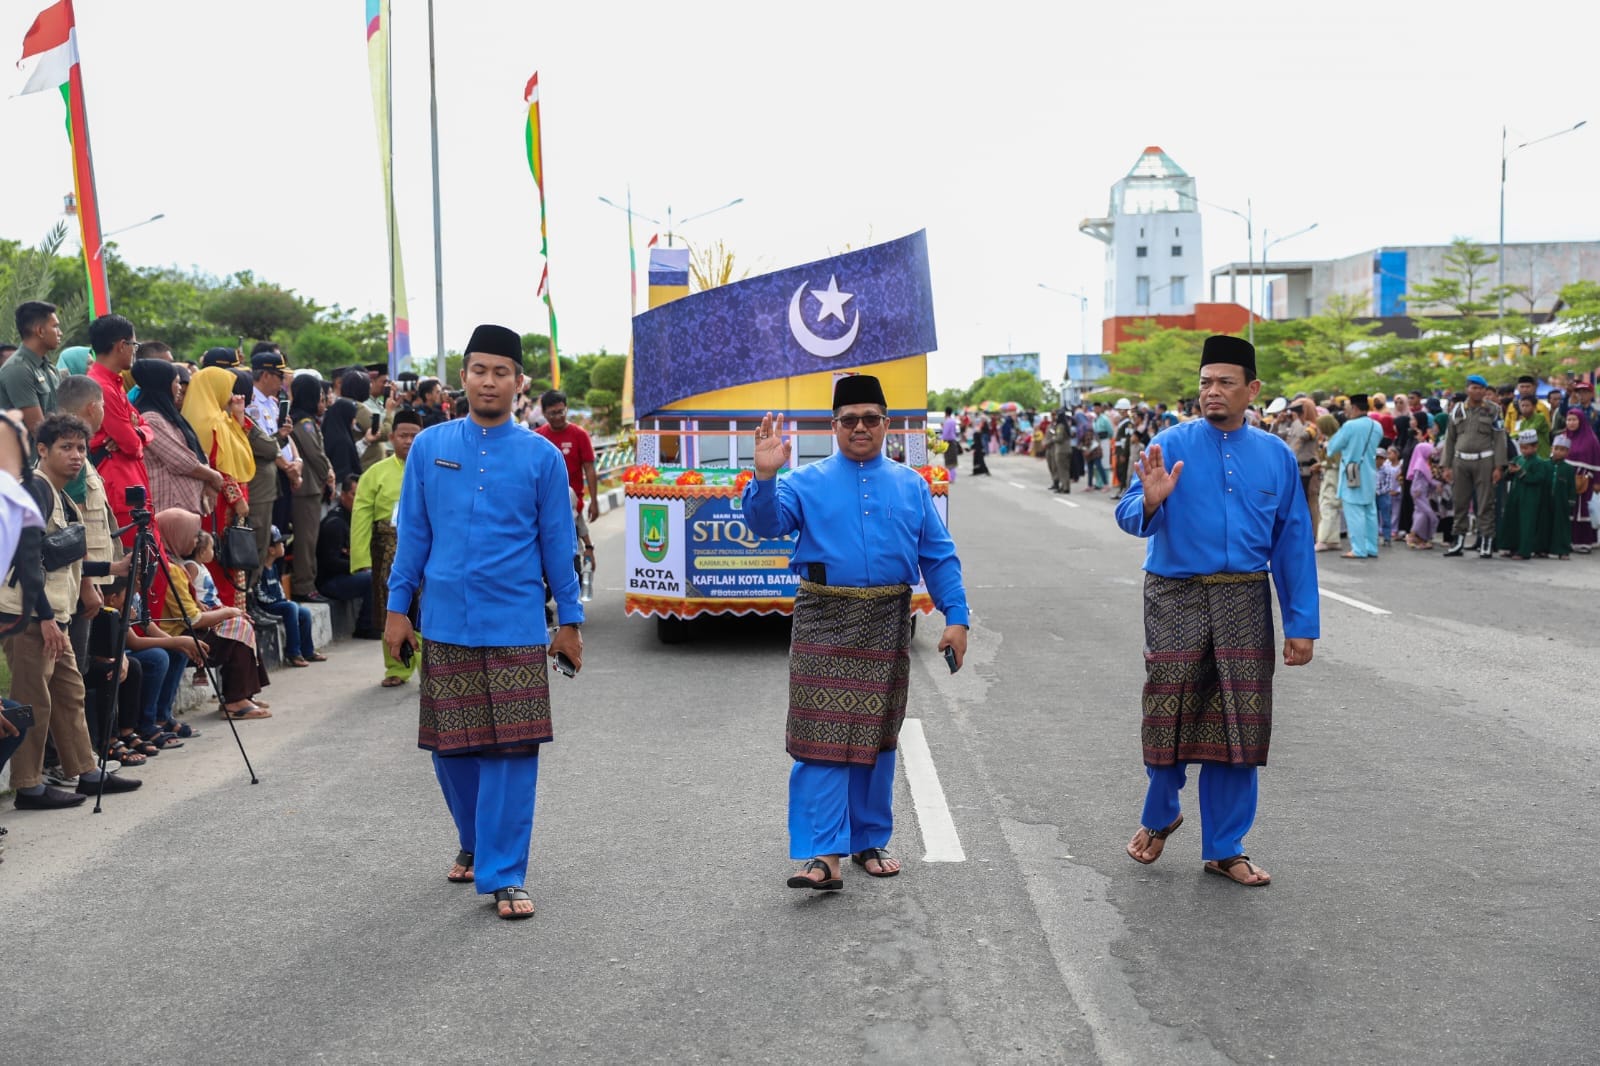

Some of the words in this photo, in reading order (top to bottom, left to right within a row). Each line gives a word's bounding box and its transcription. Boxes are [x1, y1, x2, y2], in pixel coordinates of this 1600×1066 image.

[635, 567, 674, 580] KOTA
[630, 578, 680, 592] BATAM
[692, 575, 736, 585] KAFILAH
[738, 575, 765, 585] KOTA
[767, 575, 801, 585] BATAM
[710, 588, 782, 596] #BatamKotaBaru
